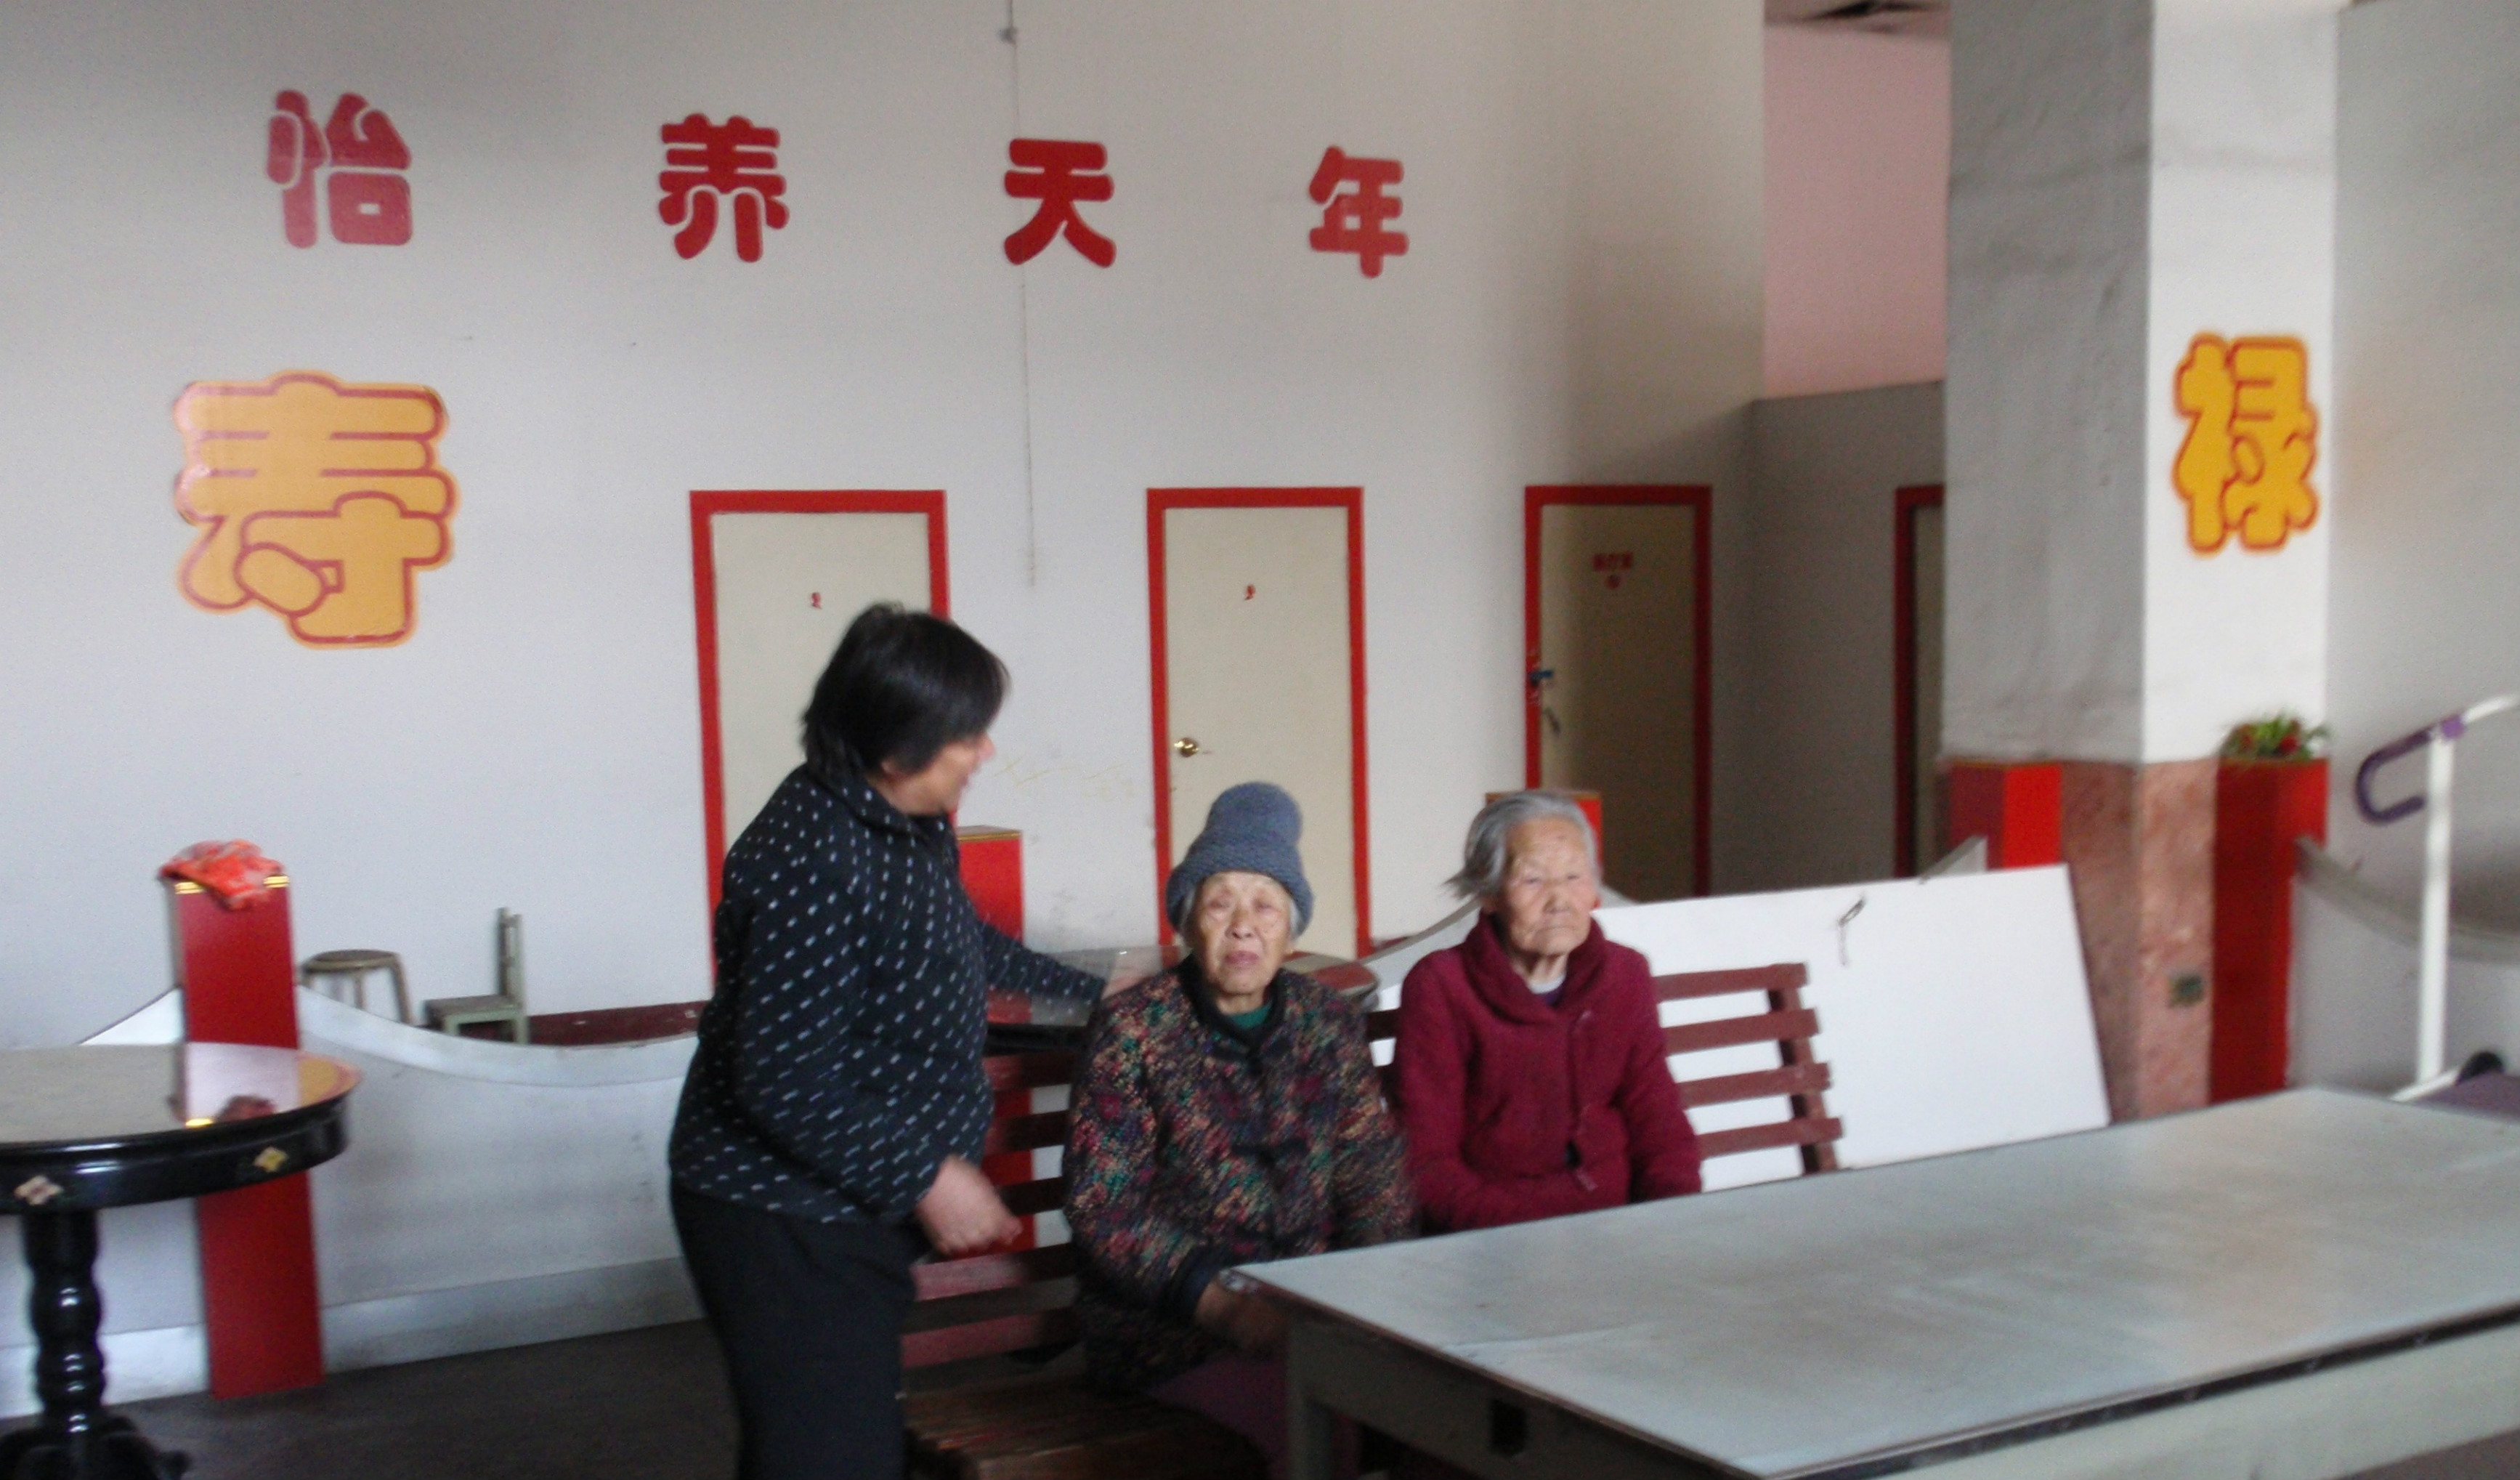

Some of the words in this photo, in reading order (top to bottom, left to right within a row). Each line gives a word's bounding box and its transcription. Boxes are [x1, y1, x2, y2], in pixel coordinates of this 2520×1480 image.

[266, 89, 1410, 278] 怡养天年
[174, 371, 460, 649] 寿
[2171, 331, 2320, 557] 禄
